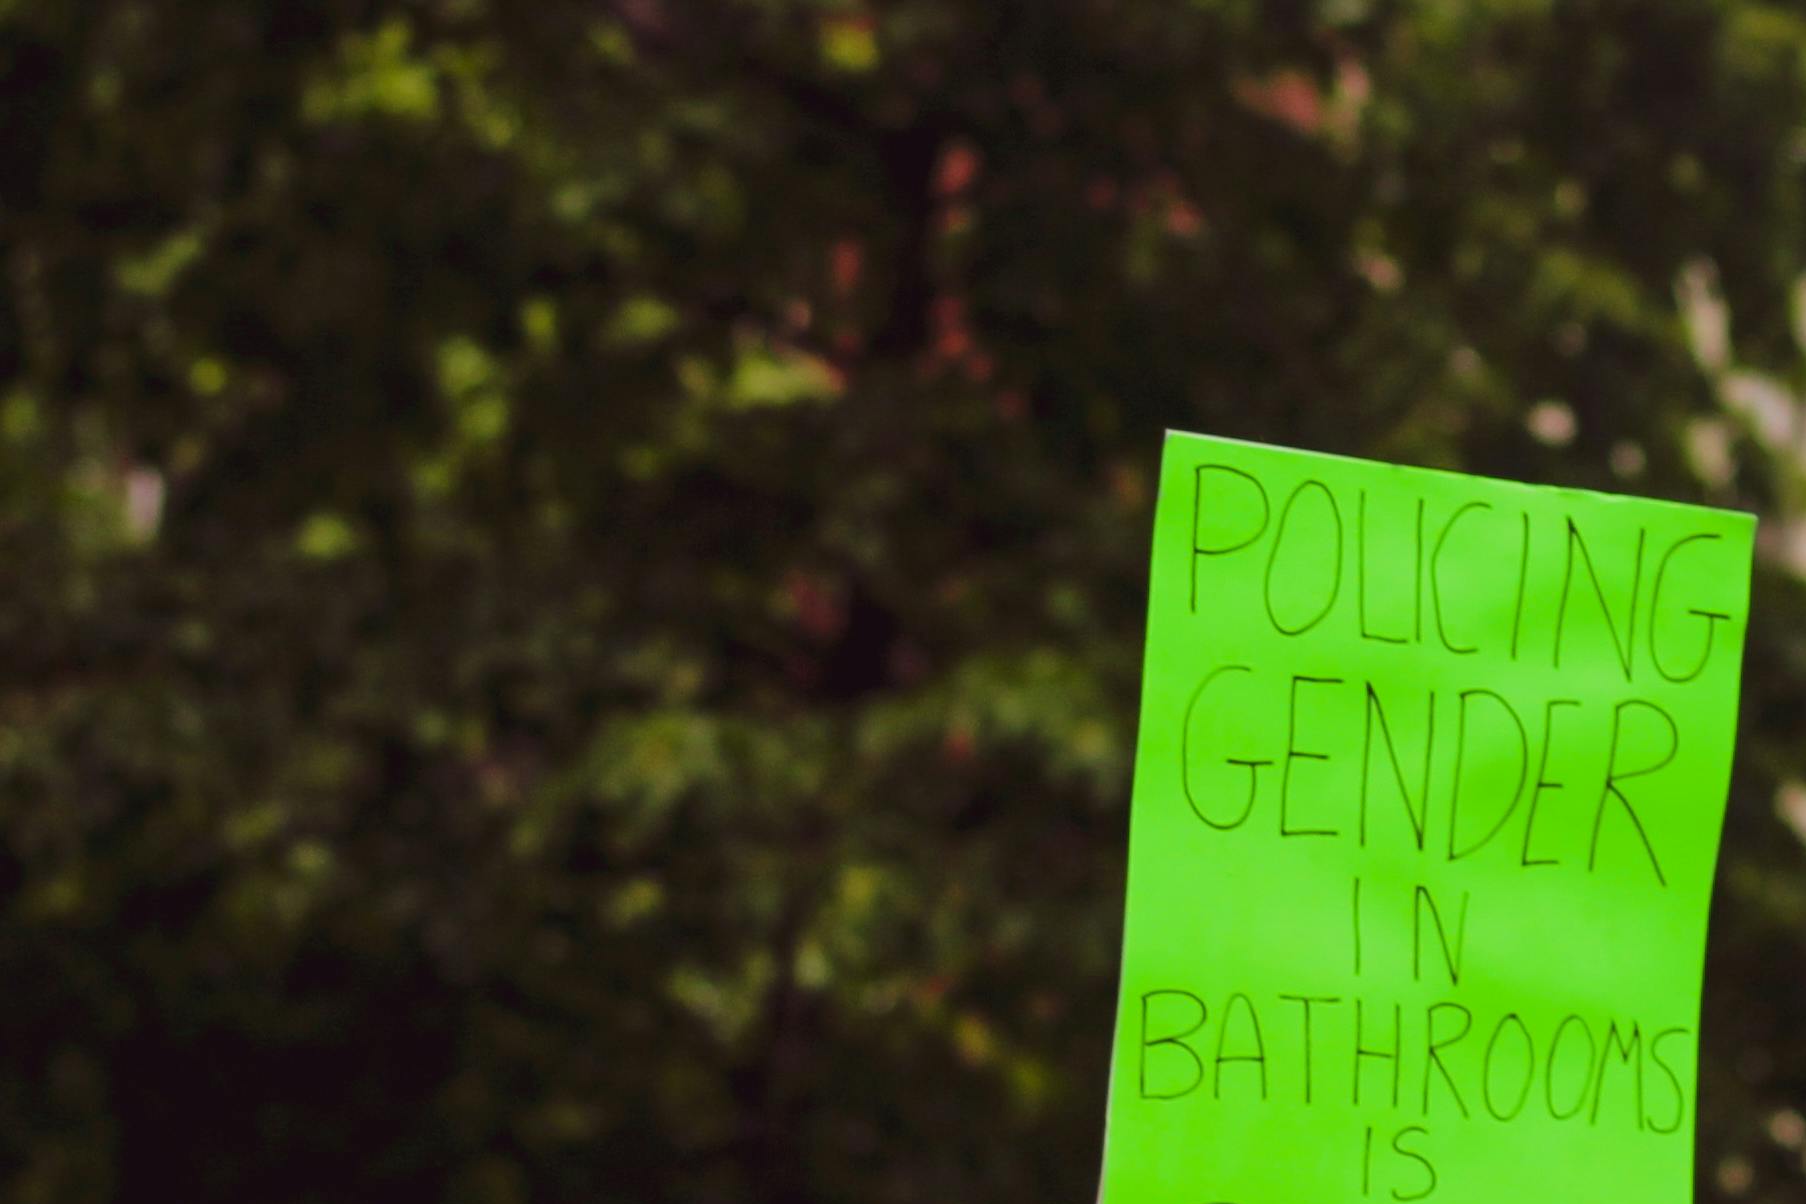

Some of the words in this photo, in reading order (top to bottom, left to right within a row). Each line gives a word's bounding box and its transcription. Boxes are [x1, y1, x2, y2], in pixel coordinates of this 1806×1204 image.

[1190, 463, 1732, 684] POLICING
[1181, 666, 1678, 887] GENDER
[1353, 876, 1470, 986] IN
[1139, 988, 1690, 1134] BATHROOMS
[1362, 1126, 1437, 1202] IS
